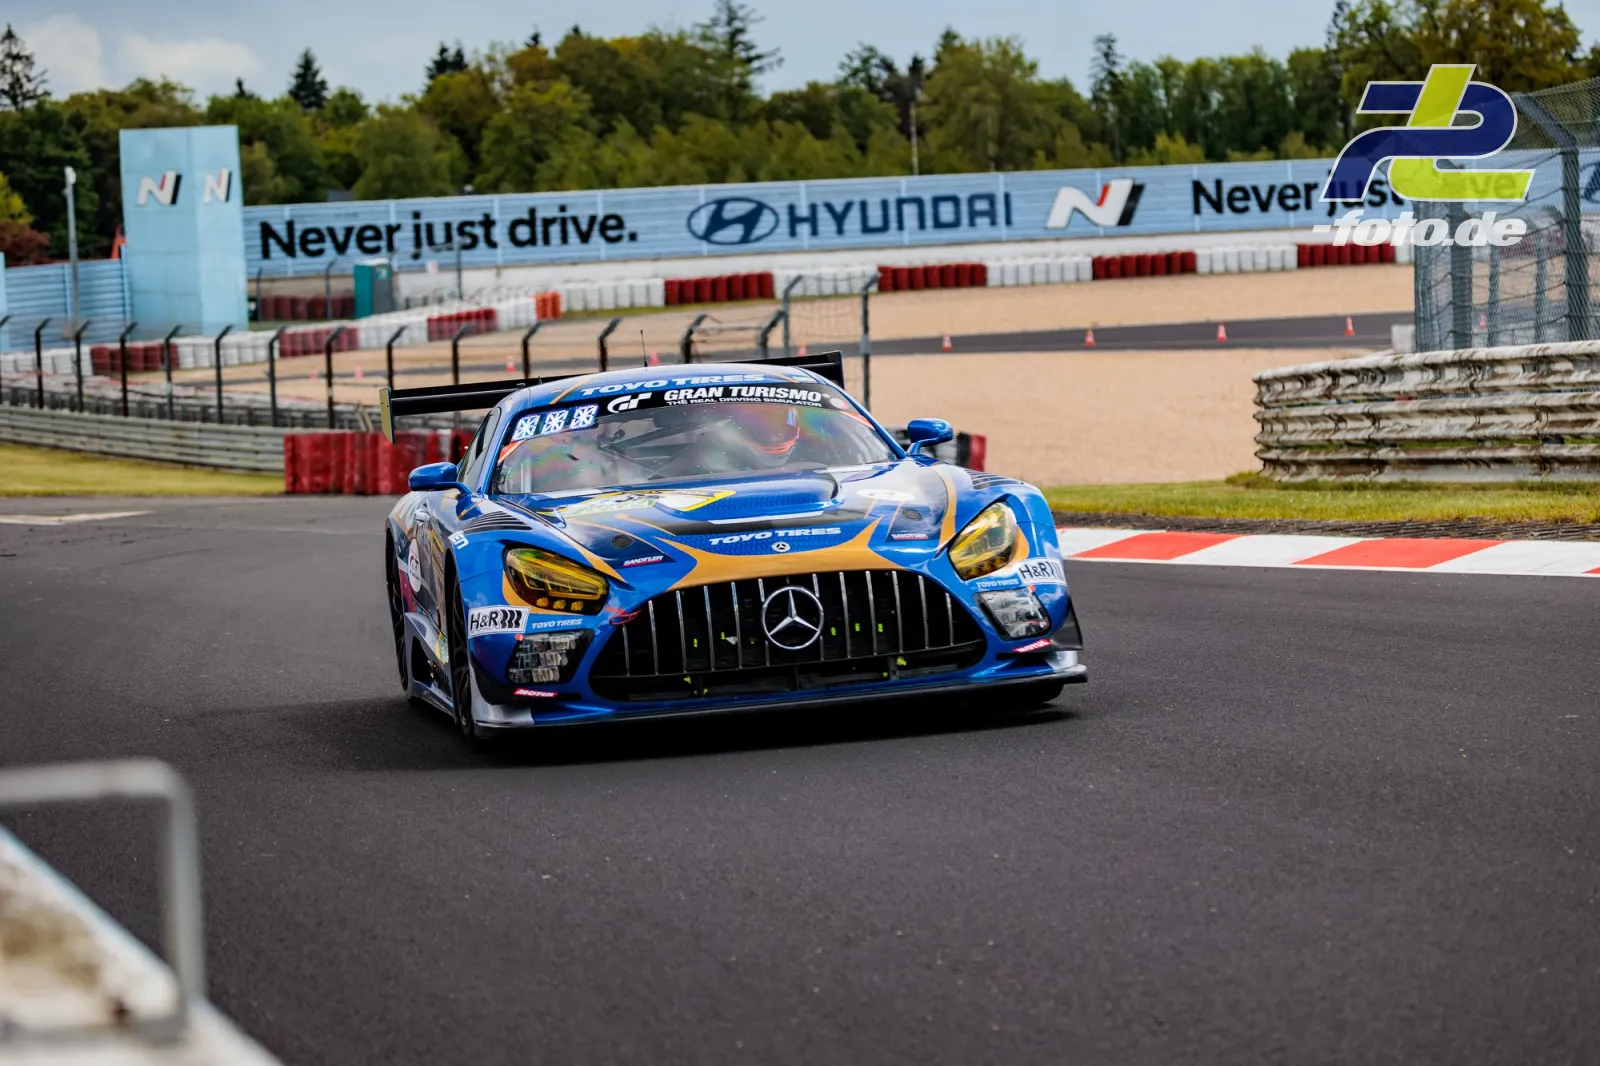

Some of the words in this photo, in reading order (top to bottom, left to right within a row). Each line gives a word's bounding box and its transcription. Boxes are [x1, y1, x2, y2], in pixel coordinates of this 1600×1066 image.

[1192, 177, 1318, 215] Never
[788, 192, 1012, 238] HYUNDAI
[260, 219, 401, 259] Never
[411, 210, 499, 260] just
[508, 204, 638, 248] drive.
[581, 380, 667, 396] TOYO
[669, 374, 766, 387] TIRES
[663, 387, 723, 401] GRAN
[729, 386, 822, 402] TURISMO
[607, 392, 652, 414] GT
[763, 397, 823, 408] SIMULATOR
[709, 531, 773, 546] TOYO
[774, 527, 842, 538] TIRES
[1018, 562, 1051, 579] H&R
[469, 611, 499, 632] H&R
[531, 620, 556, 629] TOYO
[557, 618, 583, 627] TIRES
